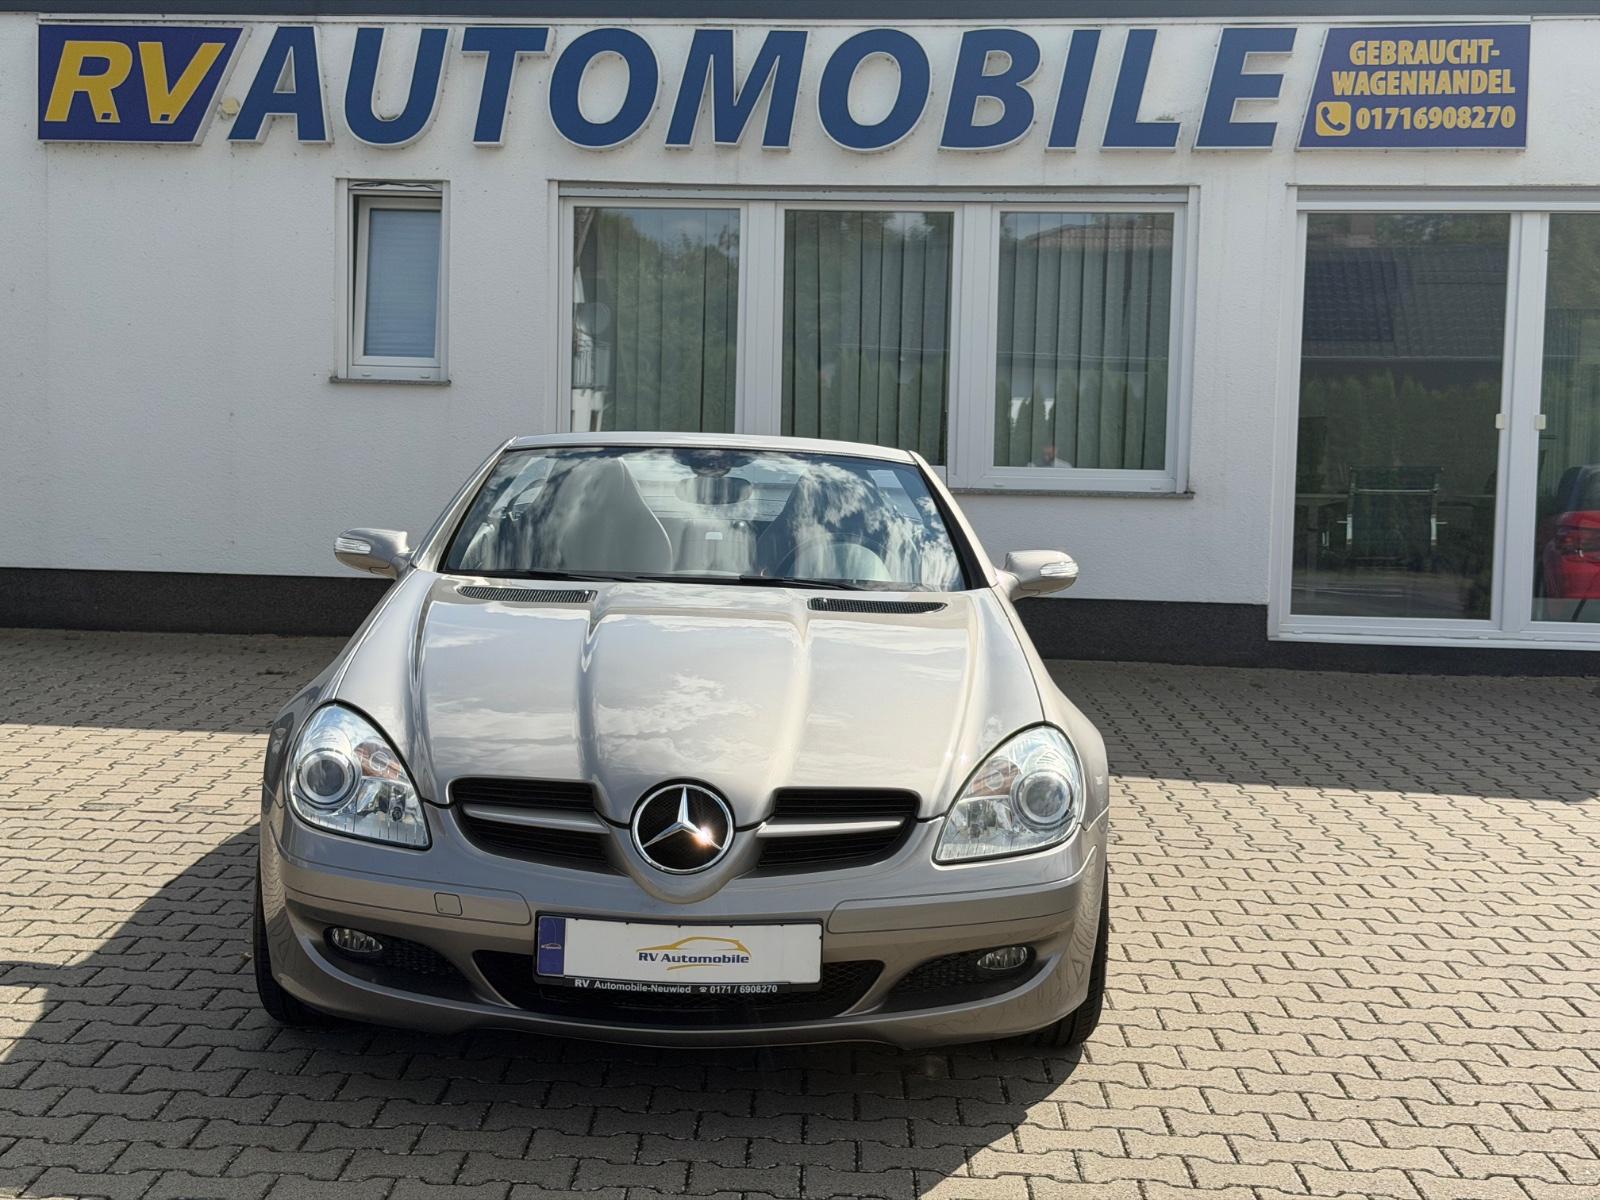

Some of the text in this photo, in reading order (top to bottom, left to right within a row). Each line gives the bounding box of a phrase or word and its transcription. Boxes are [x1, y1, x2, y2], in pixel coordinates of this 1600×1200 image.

[1350, 38, 1500, 66] GEBRAUCHT-
[44, 25, 1298, 151] RV AUTOMOBILE
[1332, 69, 1516, 96] WAGENHANDEL
[1356, 106, 1516, 130] 01716908270
[638, 952, 750, 964] RV Automobile
[574, 979, 590, 988] RV
[593, 980, 692, 994] Automobile-Neuwied
[709, 985, 732, 994] 0171
[739, 984, 778, 994] 6908270
